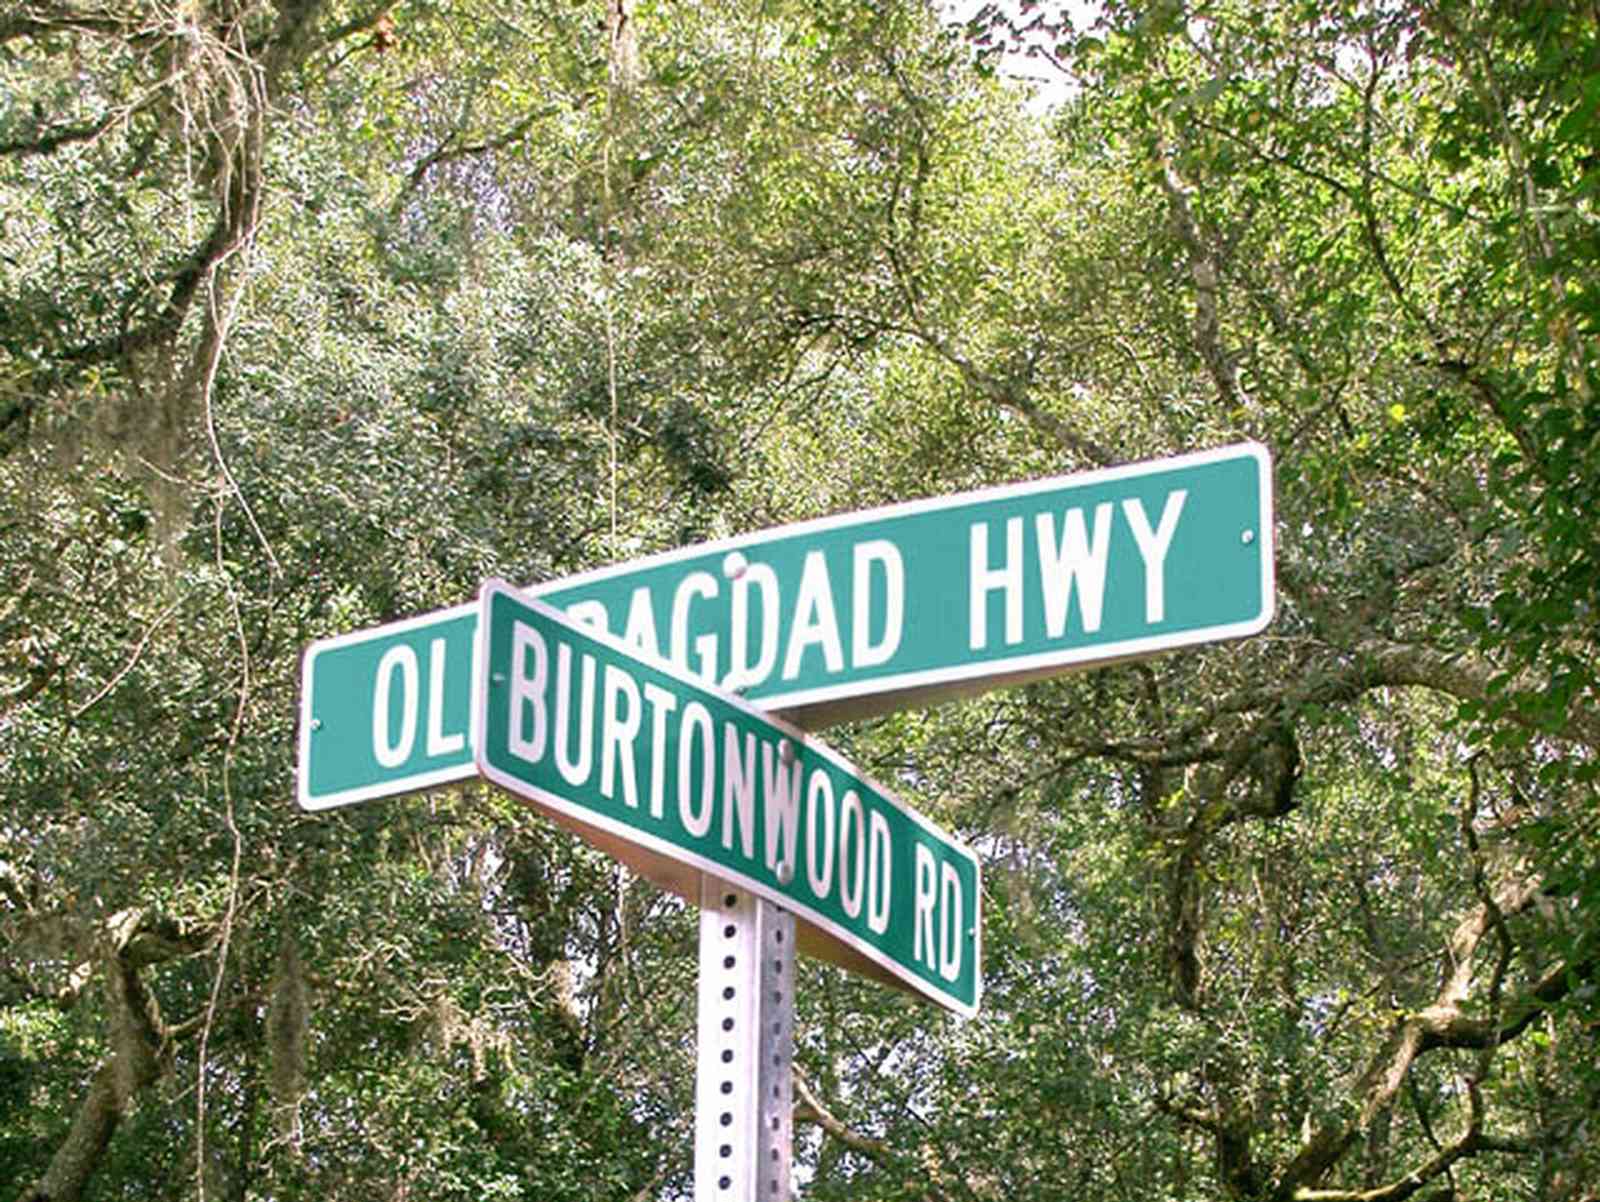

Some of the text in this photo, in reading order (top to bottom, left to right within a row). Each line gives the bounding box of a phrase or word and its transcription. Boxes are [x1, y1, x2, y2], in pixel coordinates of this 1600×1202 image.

[372, 490, 1188, 769] OL AGDAD HWY
[508, 620, 963, 983] BURTONWOOD RD
